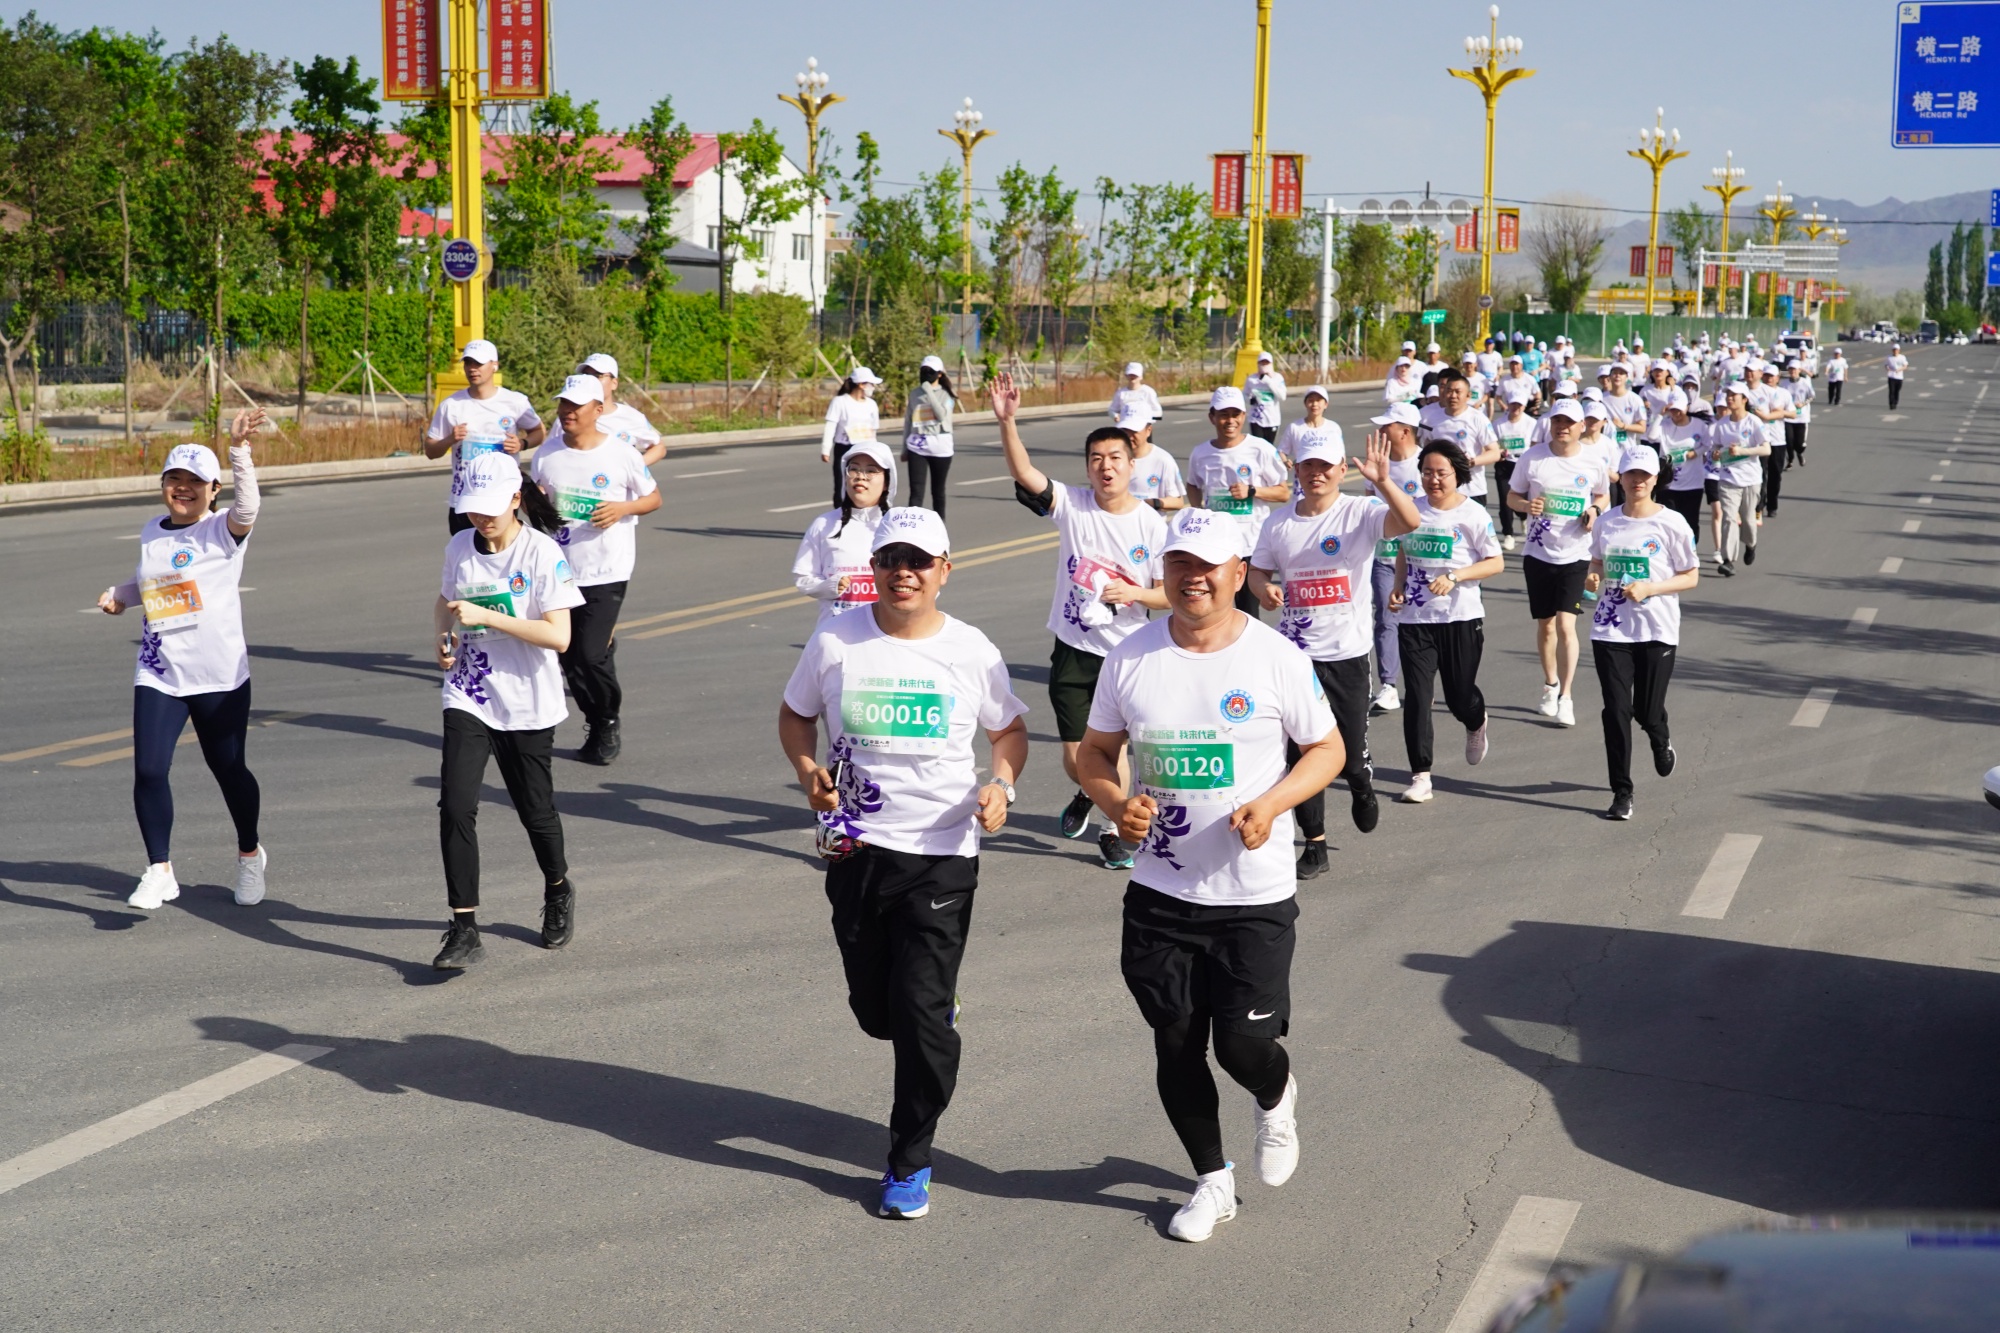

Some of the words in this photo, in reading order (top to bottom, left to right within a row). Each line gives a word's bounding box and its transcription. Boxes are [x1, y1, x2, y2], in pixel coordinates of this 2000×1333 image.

[1903, 6, 1912, 15] 北
[1916, 36, 1981, 57] 横一路
[1912, 91, 1978, 112] 横二路
[1919, 111, 1953, 119] HENGER
[445, 252, 476, 263] 33042
[562, 500, 594, 515] 0002
[1217, 501, 1248, 510] 00121
[1548, 500, 1581, 512] 00028
[1411, 541, 1447, 553] 00070
[1606, 561, 1645, 573] 00115
[1300, 584, 1345, 599] 00131
[145, 590, 193, 613] 00047
[858, 677, 894, 688] 大美新疆
[899, 678, 935, 690] 我来代言
[851, 701, 864, 726] 欢乐
[866, 704, 941, 726] 00016
[1179, 729, 1216, 740] 我来代言
[1143, 752, 1153, 776] 欢乐
[1153, 756, 1224, 777] 00120
